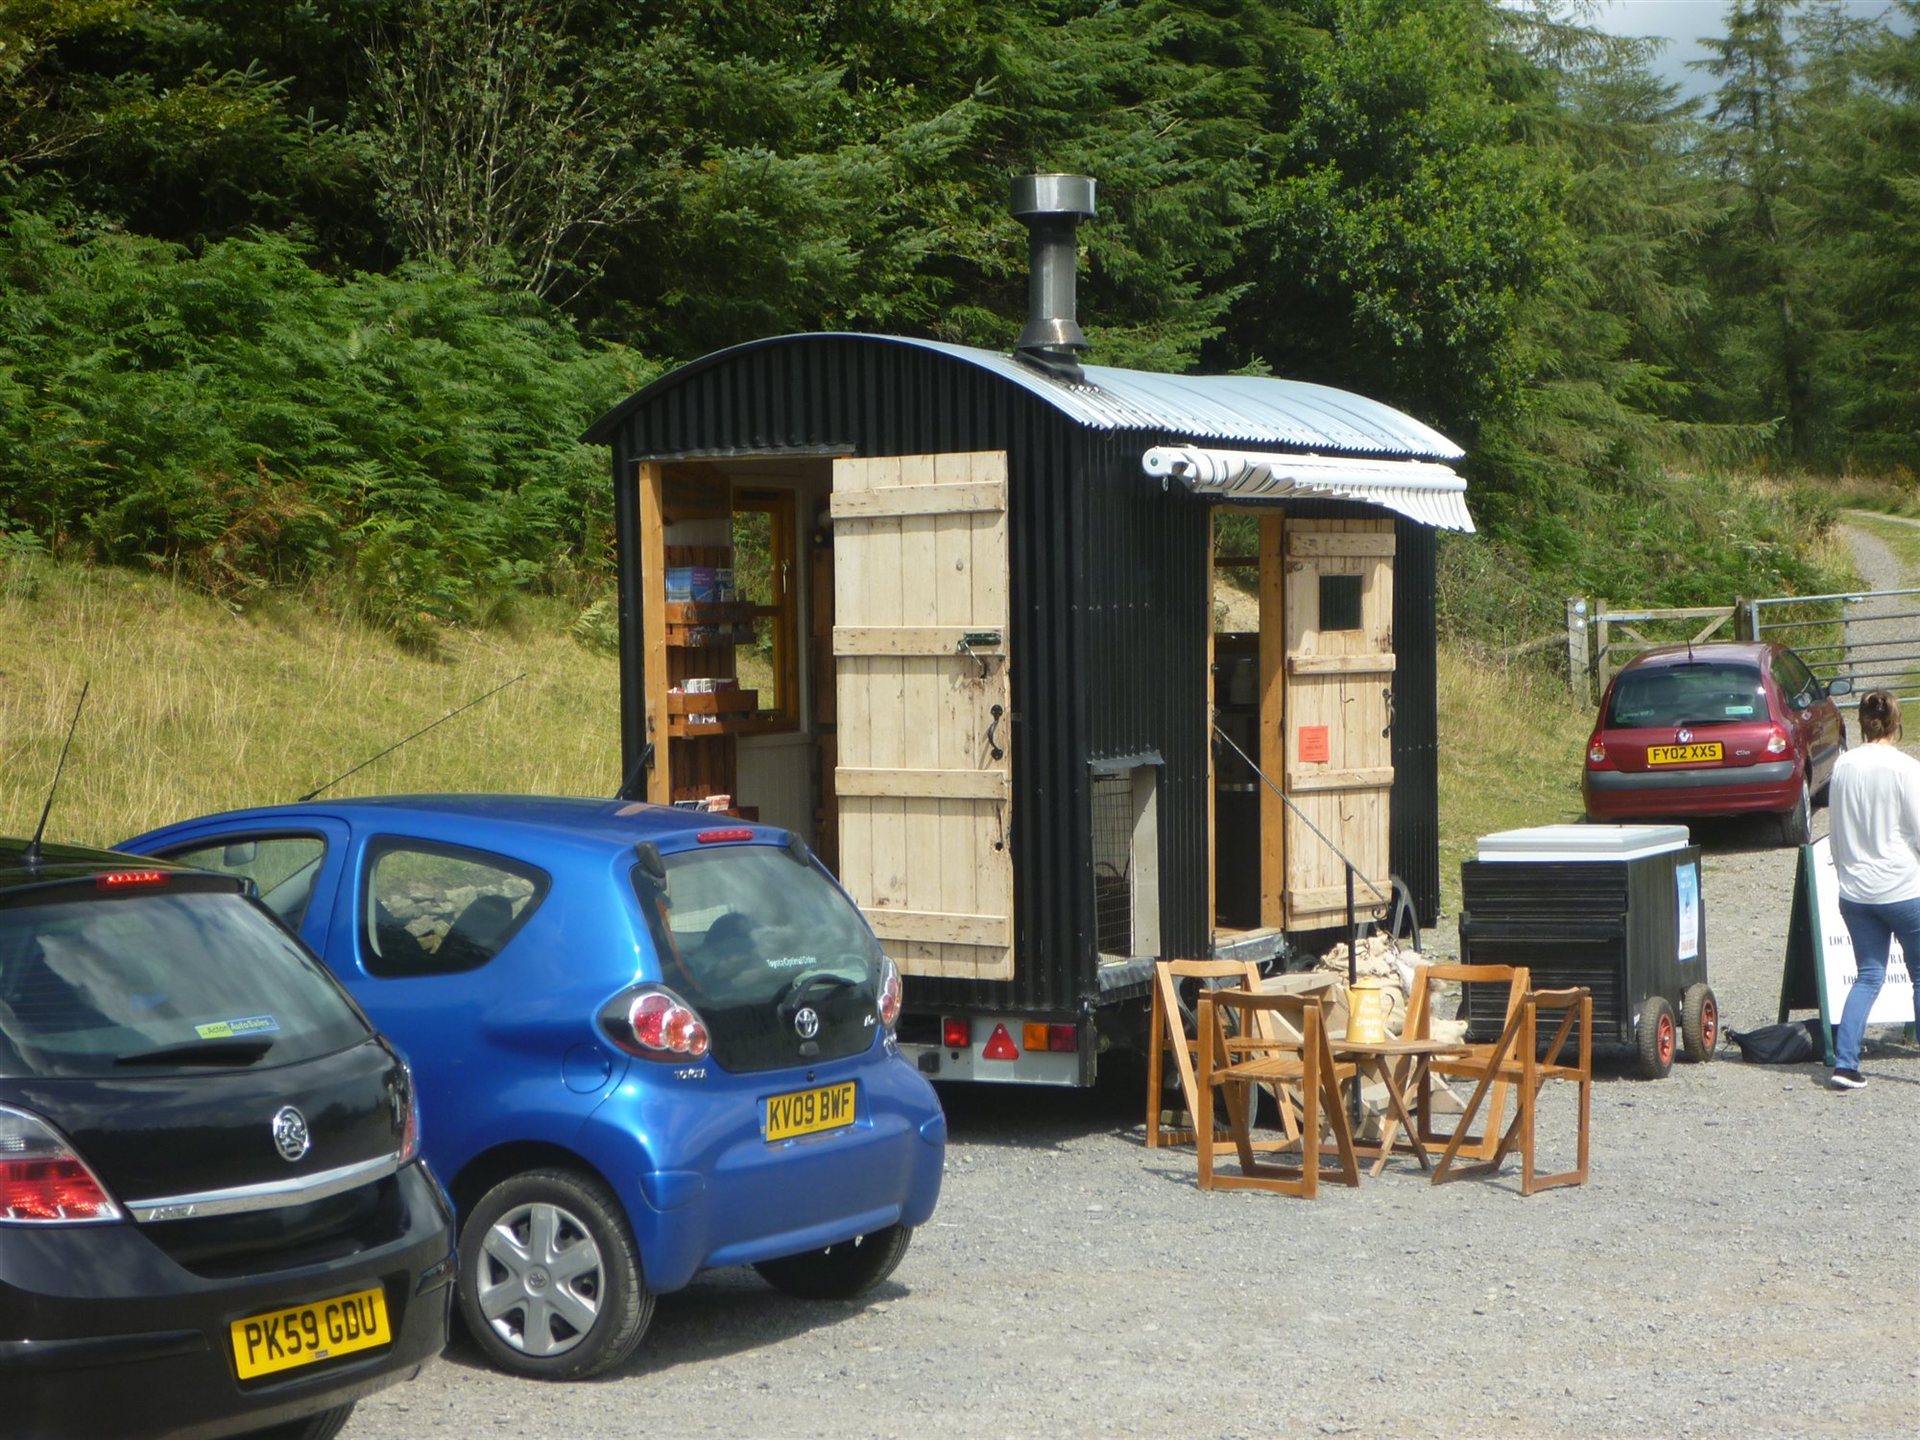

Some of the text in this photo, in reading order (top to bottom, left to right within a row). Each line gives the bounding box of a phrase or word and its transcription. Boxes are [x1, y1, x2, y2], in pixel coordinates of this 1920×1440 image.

[1653, 745, 1717, 761] FY02 XXS
[770, 1086, 852, 1132] KV09 BWF
[244, 1295, 377, 1365] PK59 GDU
